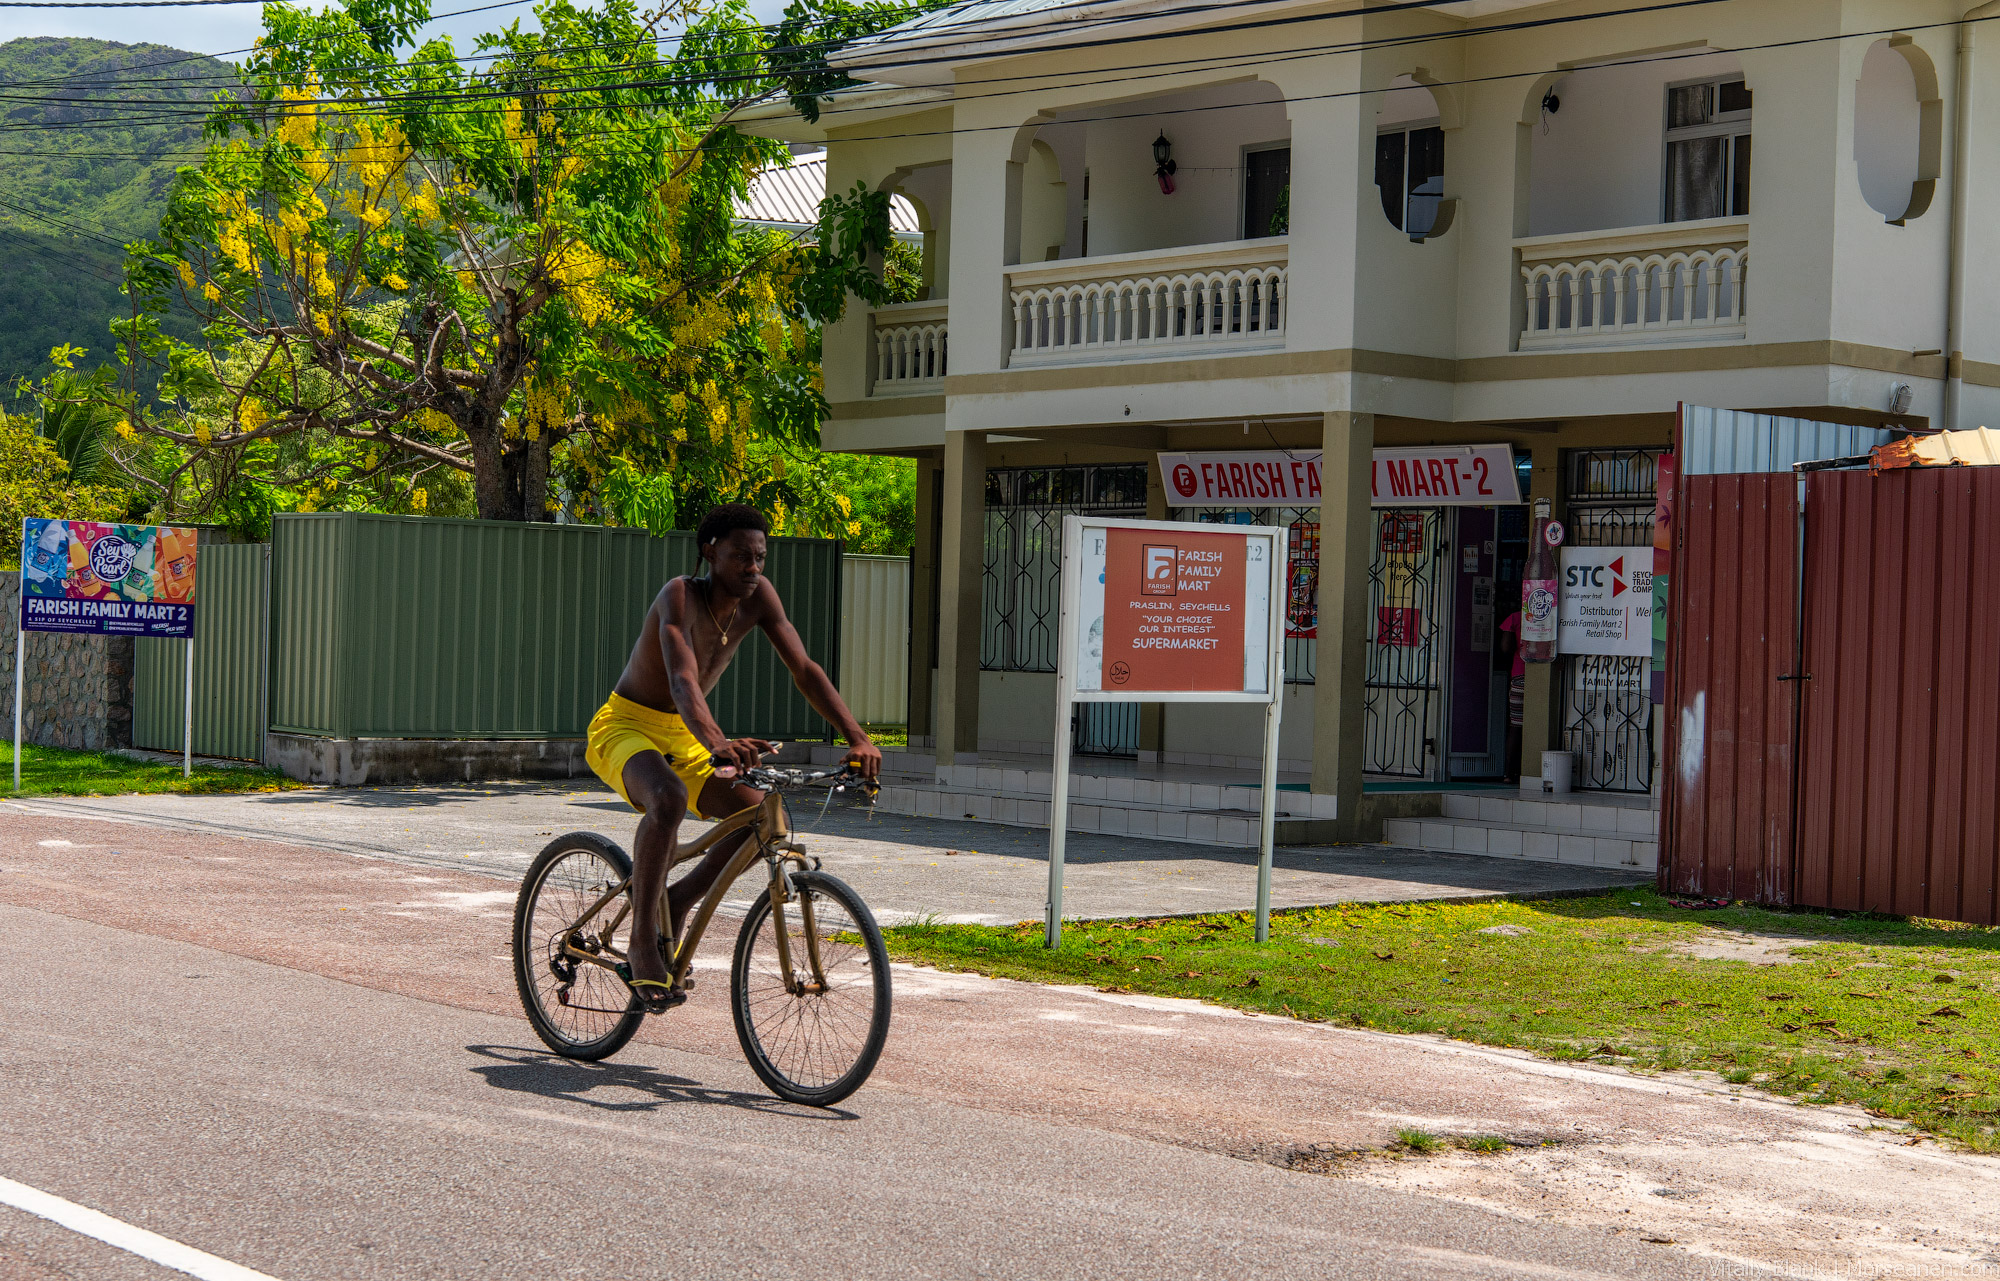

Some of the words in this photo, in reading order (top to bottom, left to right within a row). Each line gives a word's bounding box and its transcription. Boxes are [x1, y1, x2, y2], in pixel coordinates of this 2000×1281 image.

[1201, 462, 1287, 498] FARISH
[1386, 457, 1493, 497] MART-2
[97, 540, 122, 564] Sey
[1178, 550, 1223, 563] FARISH
[94, 557, 127, 575] Pearl
[1178, 565, 1222, 578] FAMILY
[1566, 565, 1605, 588] STC
[1177, 580, 1211, 592] MART
[28, 598, 79, 616] FARISH
[81, 602, 132, 619] FAMILY
[134, 604, 176, 622] MART
[178, 606, 188, 622] 2
[1129, 601, 1175, 611] PRASLIN,
[1179, 602, 1231, 612] SEYCHELLS
[1580, 605, 1623, 617] Distributor
[58, 617, 97, 625] SEYCHELLES
[1176, 616, 1213, 624] CHOICE
[1558, 618, 1578, 628] Farish
[1578, 619, 1601, 630] Family
[1601, 620, 1617, 628] Mart
[1618, 621, 1623, 629] 2
[1139, 625, 1159, 633] OUR
[1586, 629, 1605, 638] Retail
[1605, 629, 1622, 640] Shop
[1132, 637, 1219, 650] SUPERMARKET
[1581, 655, 1644, 676] FARISH
[1583, 678, 1614, 687] FAMILY
